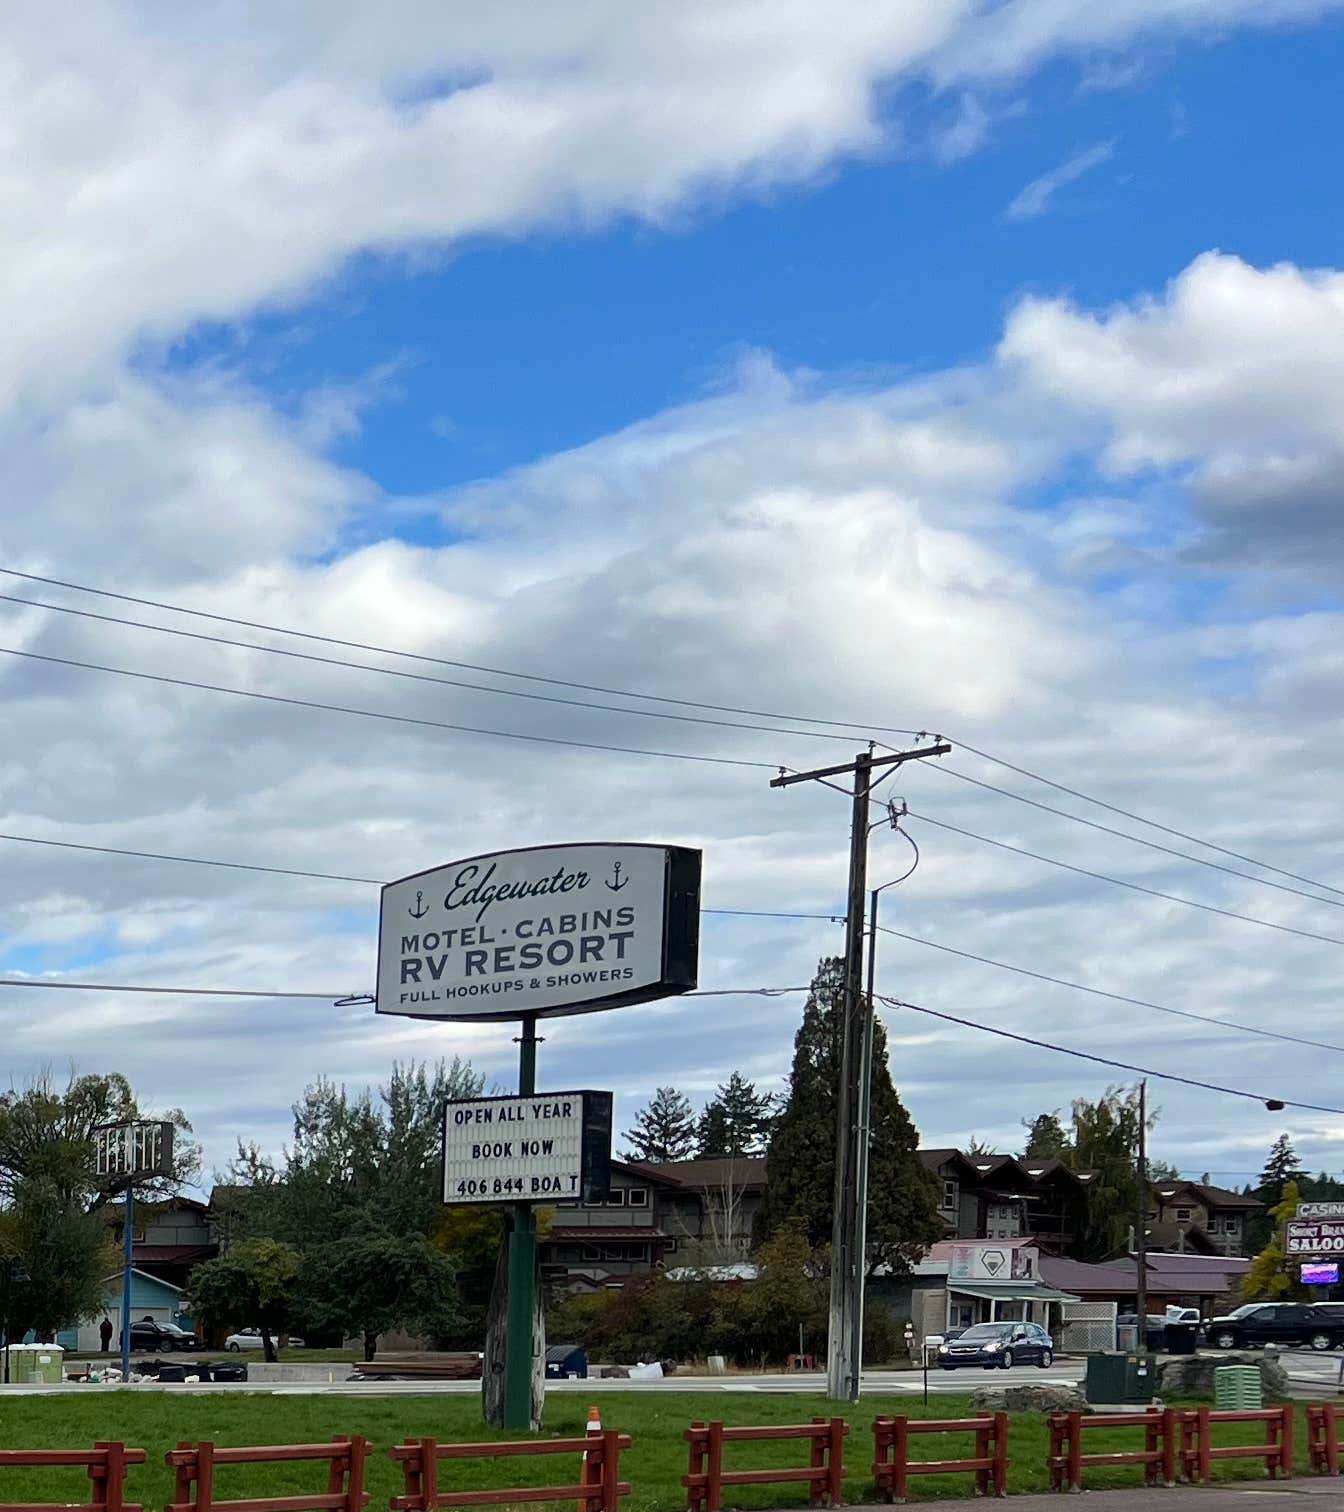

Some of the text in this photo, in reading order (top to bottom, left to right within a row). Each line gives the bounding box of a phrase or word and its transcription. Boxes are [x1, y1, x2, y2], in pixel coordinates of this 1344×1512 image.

[444, 862, 591, 923] Edgewater
[400, 907, 635, 954] MOTEL CABINS
[400, 931, 635, 985] RV RESORT
[400, 967, 634, 1004] FULL HOOKUPS & SHOWERS
[454, 1102, 572, 1125] OPEN ALL YEAR
[472, 1140, 553, 1159] BOOK NOW
[457, 1179, 487, 1197] 406
[493, 1178, 524, 1193] 844
[1300, 1204, 1344, 1217] CASIN
